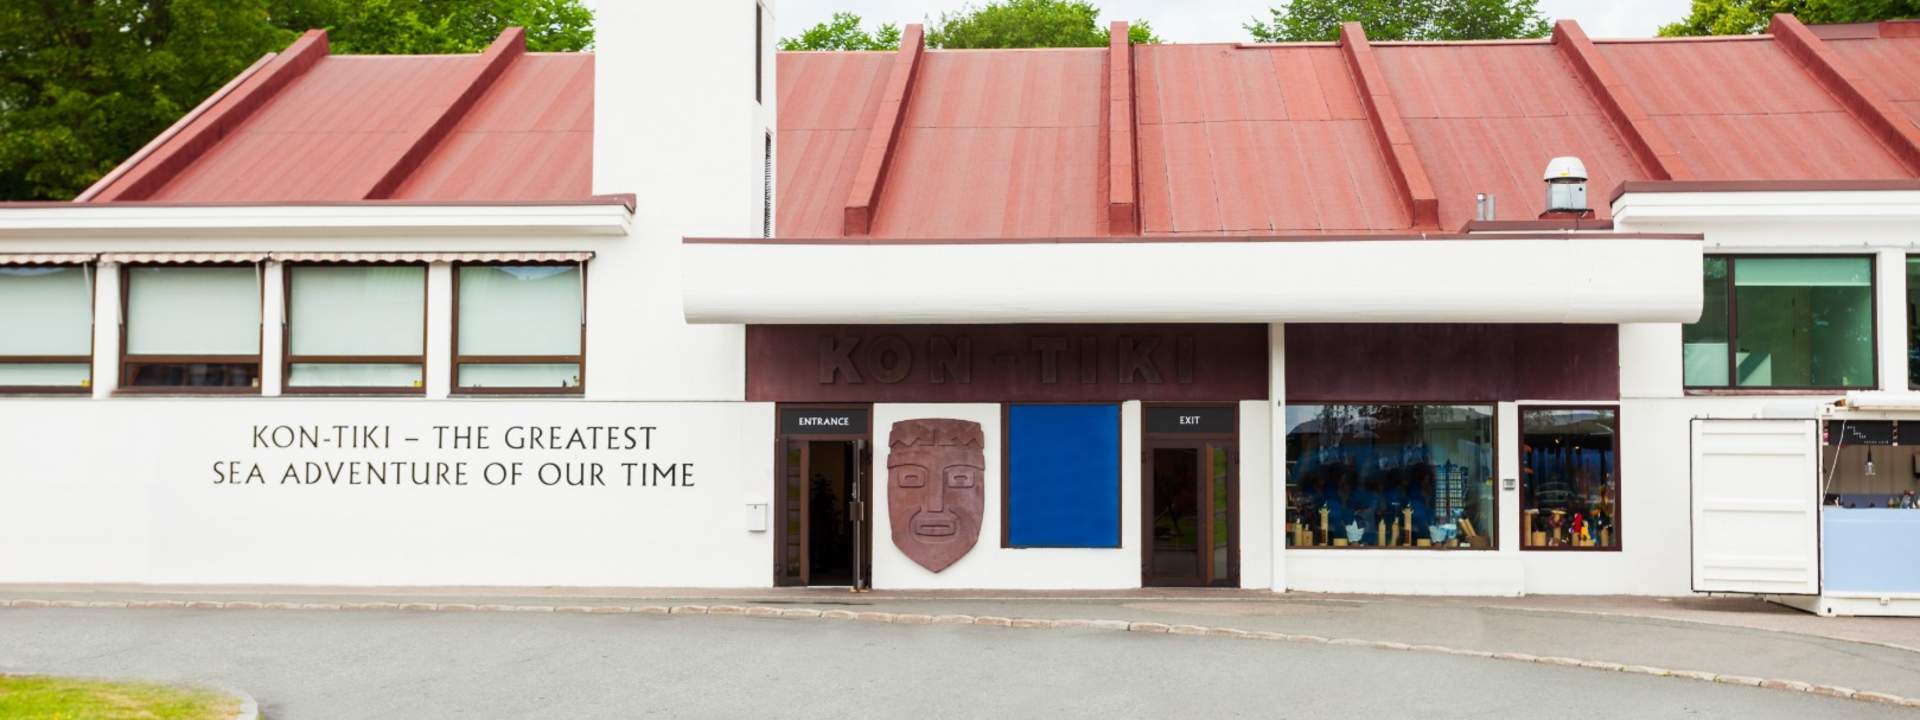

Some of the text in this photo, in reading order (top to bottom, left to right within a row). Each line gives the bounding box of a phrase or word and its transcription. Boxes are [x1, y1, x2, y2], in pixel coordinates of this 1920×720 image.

[817, 335, 1196, 385] KON-TIKI
[797, 416, 849, 427] ENTRANCE
[1178, 415, 1201, 425] EXIT
[252, 424, 390, 449] KON-TIKI
[432, 425, 490, 450] THE
[504, 425, 657, 451] GREATEST
[212, 460, 695, 488] SEA ADVENTURE OF OUR TIME
